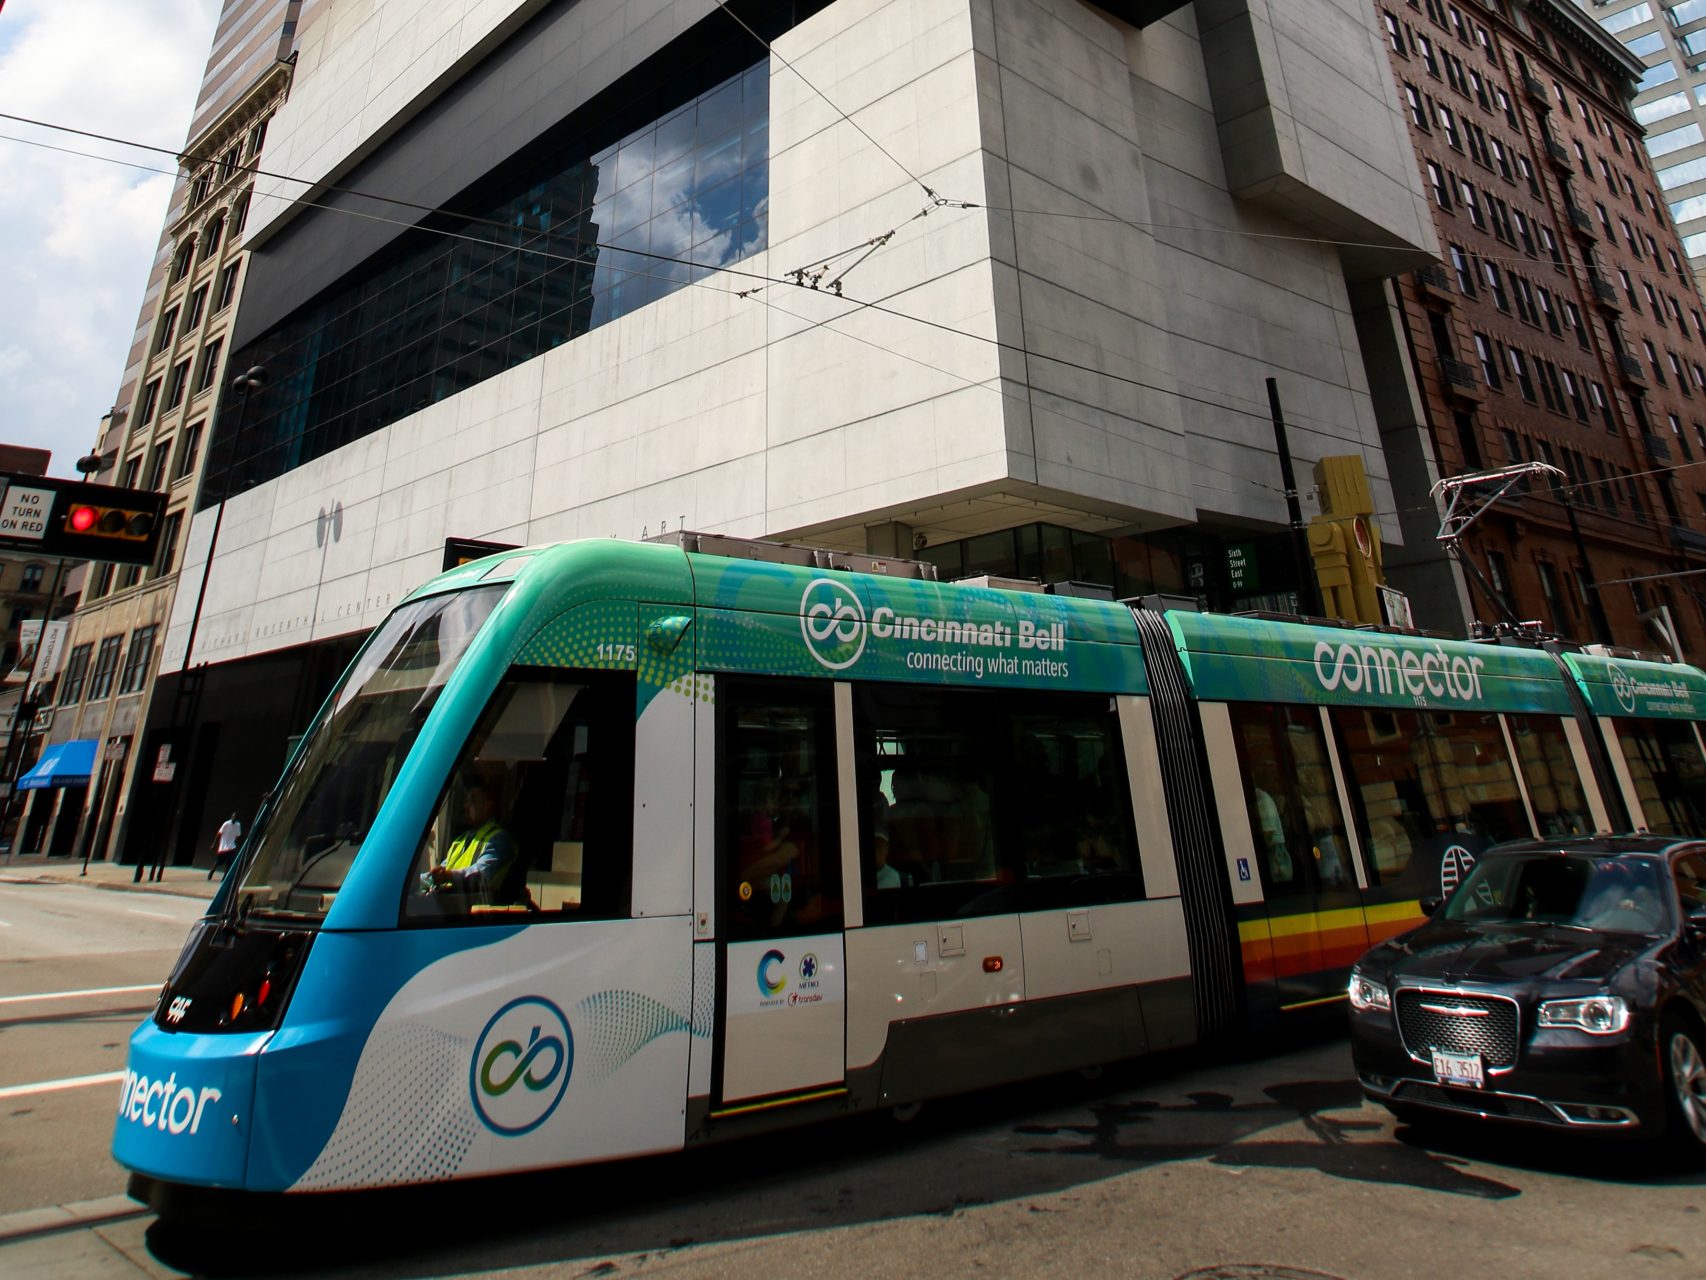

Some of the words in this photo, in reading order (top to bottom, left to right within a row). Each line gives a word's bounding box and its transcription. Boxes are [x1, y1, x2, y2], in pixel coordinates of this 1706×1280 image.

[20, 493, 40, 505] NO
[12, 506, 42, 518] TURN
[1, 520, 17, 529] ON
[21, 521, 43, 532] RED
[641, 515, 685, 540] ART
[1228, 548, 1242, 558] Sixth
[1230, 558, 1246, 568] Street
[1231, 569, 1243, 578] East
[256, 610, 326, 638] ROSENTHL
[337, 593, 391, 618] CENTER
[871, 606, 1011, 647] Cincinnati
[1018, 620, 1065, 651] Bell
[596, 643, 635, 661] 1175
[906, 650, 983, 678] connecting
[988, 652, 1019, 675] what
[1022, 657, 1069, 678] matters
[1313, 640, 1484, 701] connector
[1413, 695, 1427, 707] 1175
[799, 980, 819, 989] METRO
